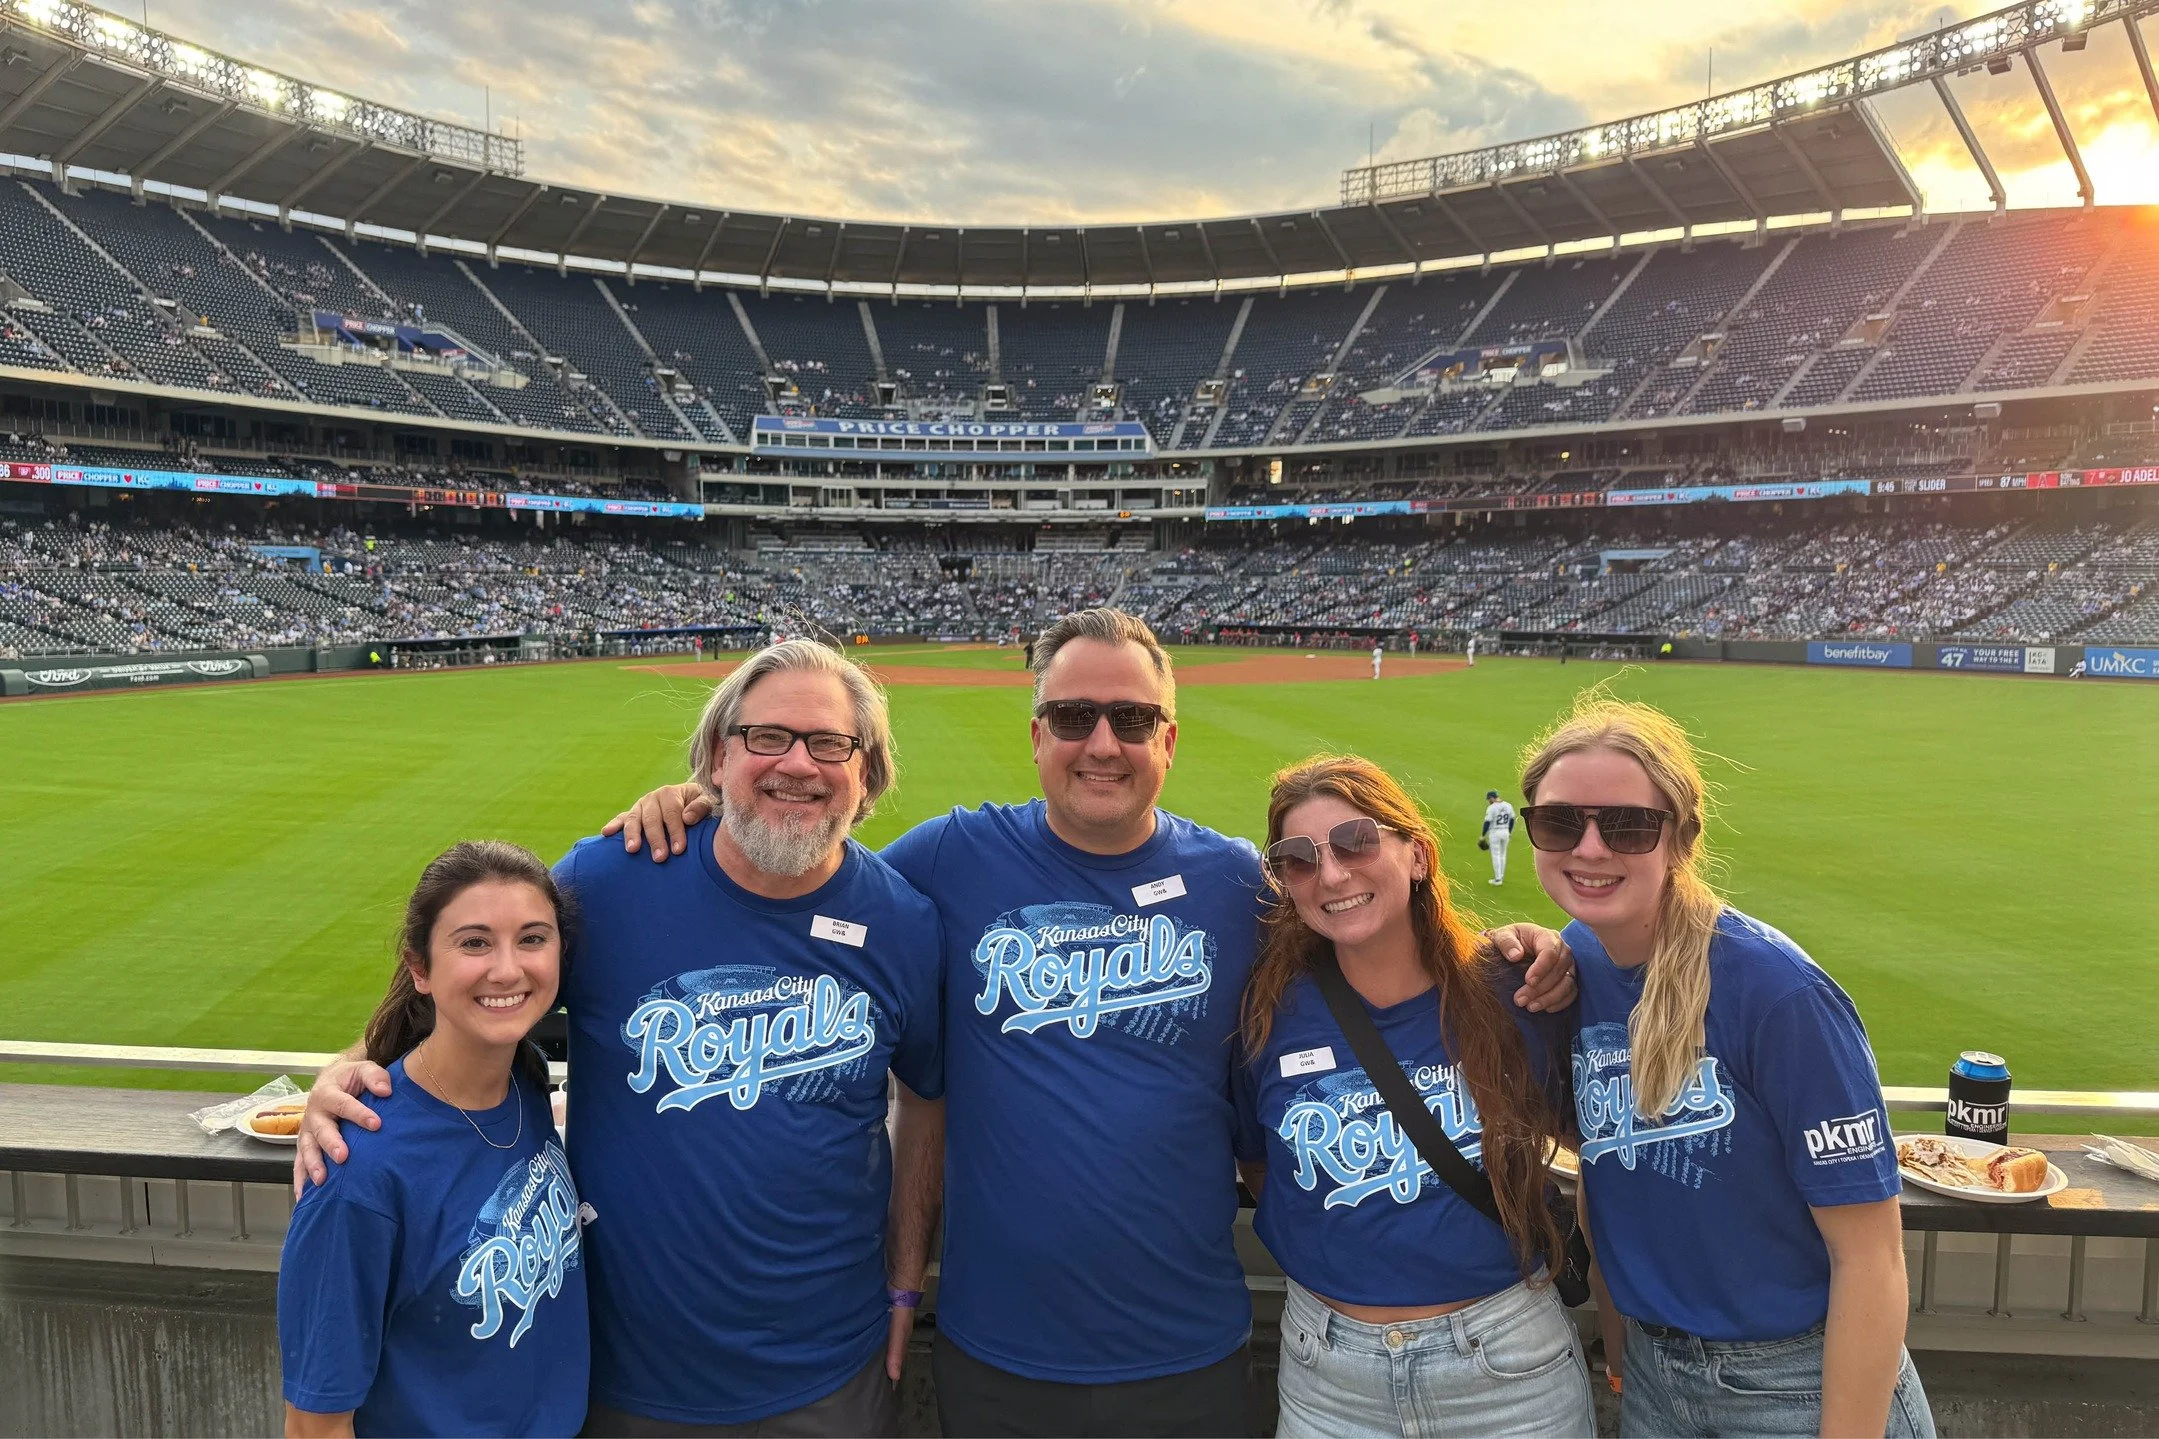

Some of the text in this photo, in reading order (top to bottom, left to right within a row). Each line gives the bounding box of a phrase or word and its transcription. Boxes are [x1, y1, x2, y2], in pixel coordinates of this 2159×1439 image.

[838, 421, 1060, 436] PRICE CHOPPER
[31, 465, 51, 480] .300
[57, 471, 80, 481] PRICE
[83, 473, 119, 483] CHOPPER
[2120, 468, 2132, 483] JO
[1918, 478, 1946, 492] SLIDER
[2000, 476, 2012, 488] 87
[1824, 644, 1889, 663] benefitbay
[1973, 648, 2020, 657] YOUR FREE
[199, 659, 234, 672] Ford
[1940, 653, 1965, 668] 47
[2091, 656, 2146, 673] UMKC
[39, 668, 81, 682] Ford
[1150, 880, 1165, 889] ANDY
[832, 920, 850, 930] BRIAN
[1035, 914, 1150, 950] Kansas City
[975, 914, 1211, 1039] Royals
[696, 976, 814, 1020] Kansas City
[626, 974, 875, 1114] Royals
[1415, 1065, 1455, 1091] City
[1947, 1098, 2005, 1125] pkmr
[1803, 1116, 1875, 1159] pkmr
[502, 1150, 555, 1241] Kansas City
